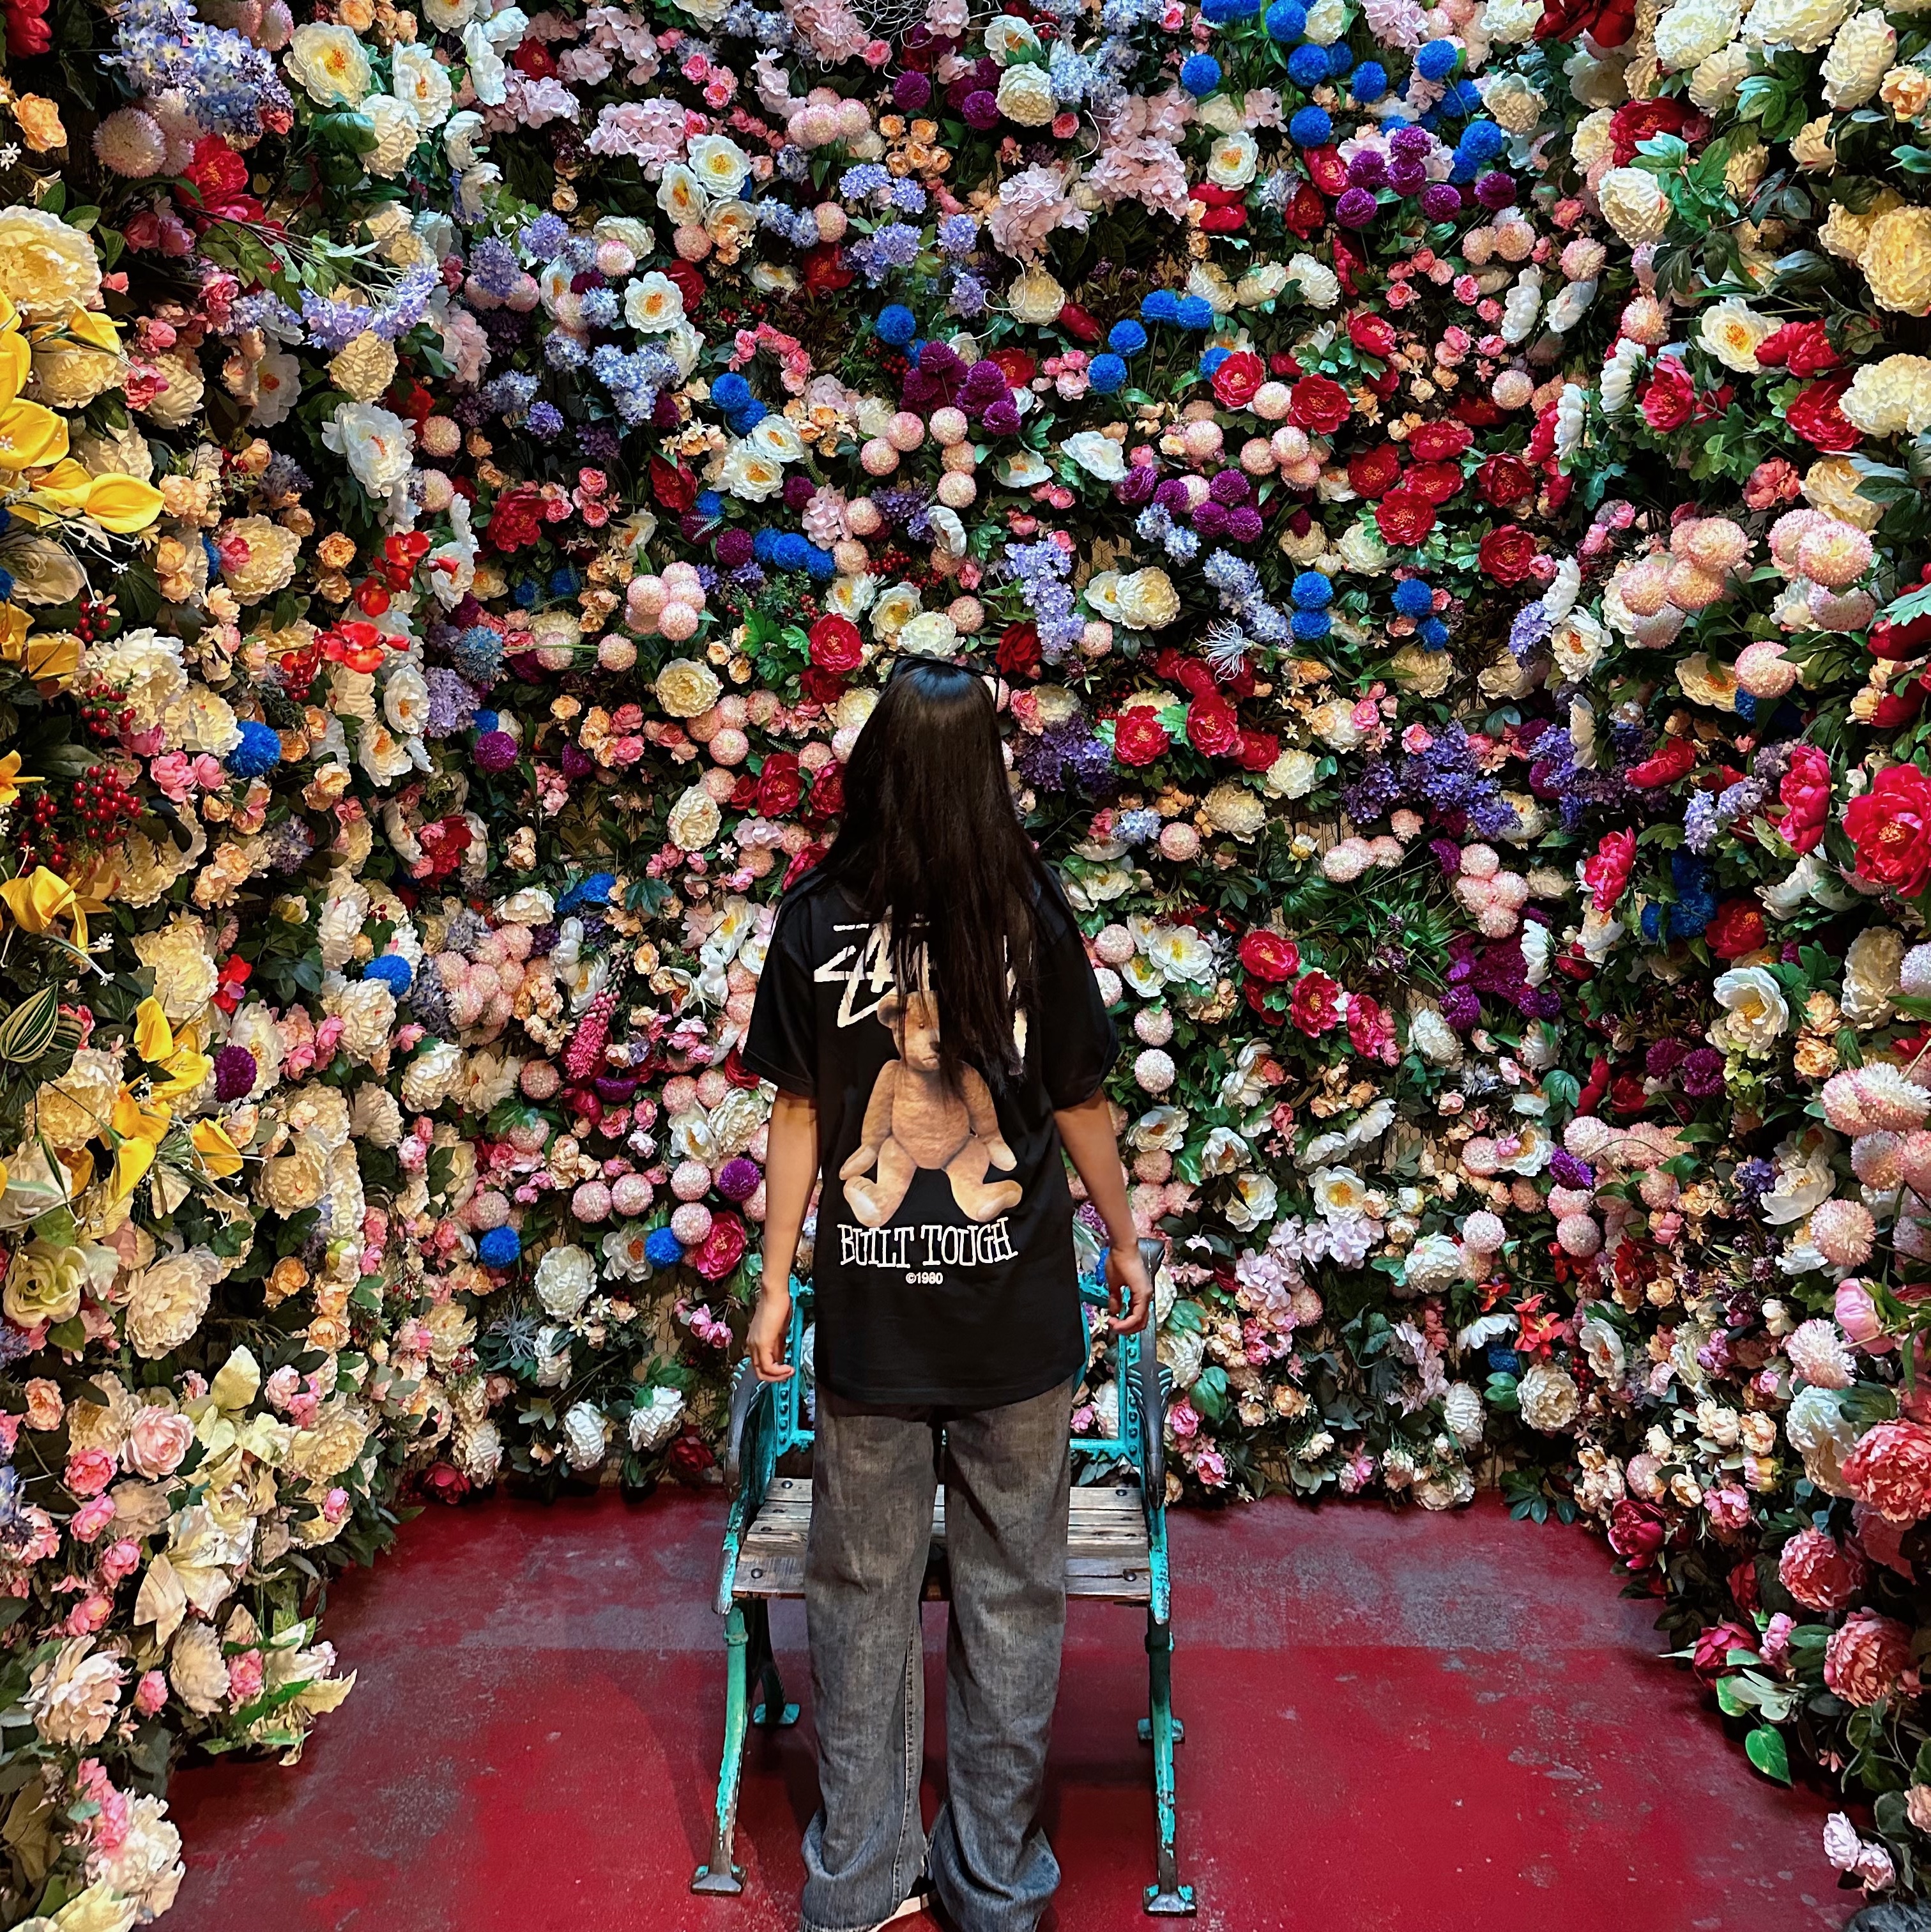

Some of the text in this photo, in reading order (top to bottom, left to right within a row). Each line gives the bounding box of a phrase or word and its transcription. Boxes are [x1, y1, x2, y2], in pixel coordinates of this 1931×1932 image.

[837, 1216, 1018, 1269] BUILT TOUGH
[905, 1272, 943, 1285] ©1980
